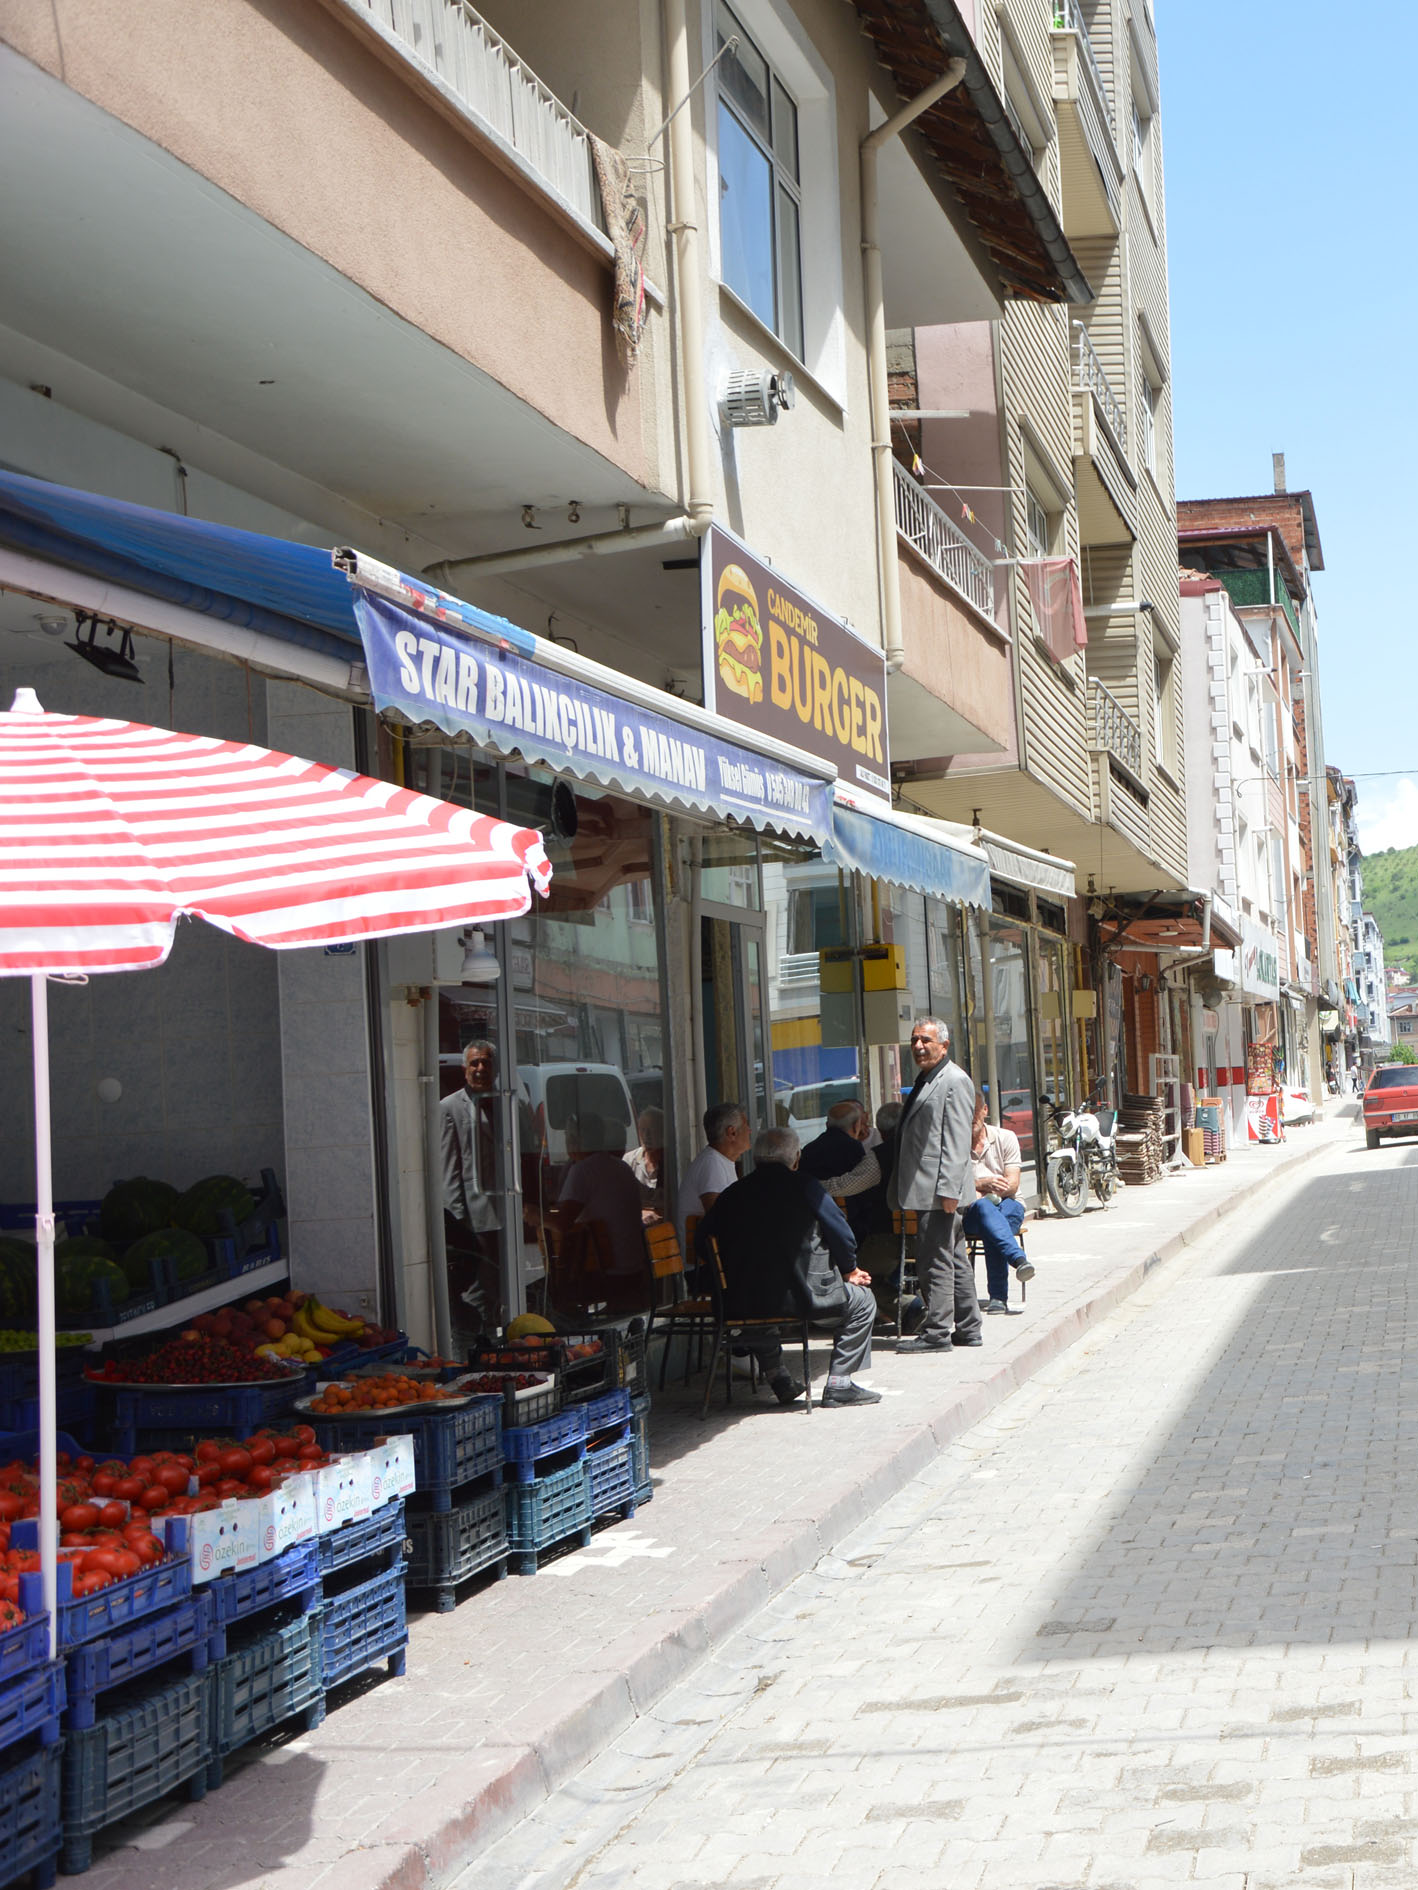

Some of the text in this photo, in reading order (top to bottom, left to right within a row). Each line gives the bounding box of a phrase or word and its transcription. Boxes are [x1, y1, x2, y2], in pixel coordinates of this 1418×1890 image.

[767, 587, 818, 647] CANDEMİR
[394, 630, 706, 793] STAR BALIKÇILIK & MANAV
[768, 619, 883, 764] BURGER
[214, 1541, 246, 1561] özekin
